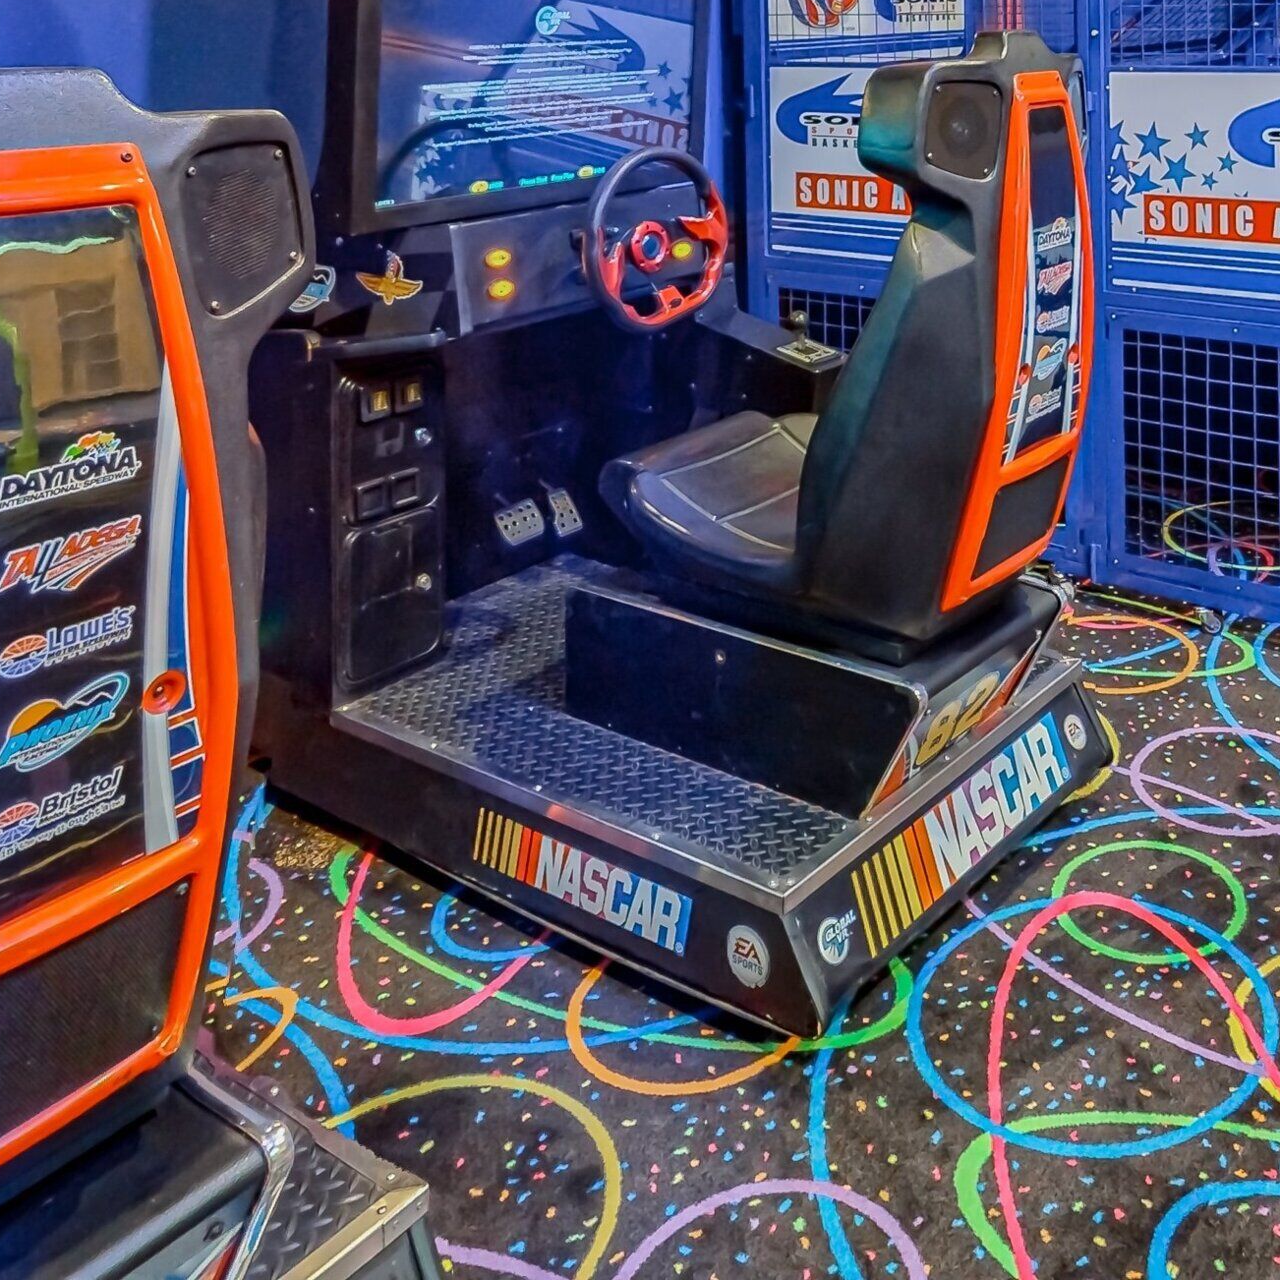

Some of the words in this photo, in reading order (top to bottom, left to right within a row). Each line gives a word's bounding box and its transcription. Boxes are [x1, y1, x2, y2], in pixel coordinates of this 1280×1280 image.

[811, 126, 853, 135] SPO
[812, 137, 858, 149] BASKE
[799, 176, 878, 210] SONIC
[1149, 199, 1255, 238] SONIC
[1038, 227, 1071, 246] DAYTONA
[0, 483, 80, 510] INTERNATIONAL
[83, 468, 137, 488] SPEEDWAY
[1, 447, 137, 501] DAYTONA
[47, 607, 131, 652] LOWE'S
[47, 643, 81, 658] MOTOR
[38, 810, 67, 826] Motor
[68, 788, 116, 814] Speedway
[40, 766, 123, 815] Bristol
[922, 721, 1065, 886] NASCAR
[535, 835, 681, 951] NASCAR
[826, 909, 857, 942] GLOBAL
[837, 928, 850, 944] VR
[732, 954, 764, 976] SPORTS
[734, 937, 762, 966] EA
